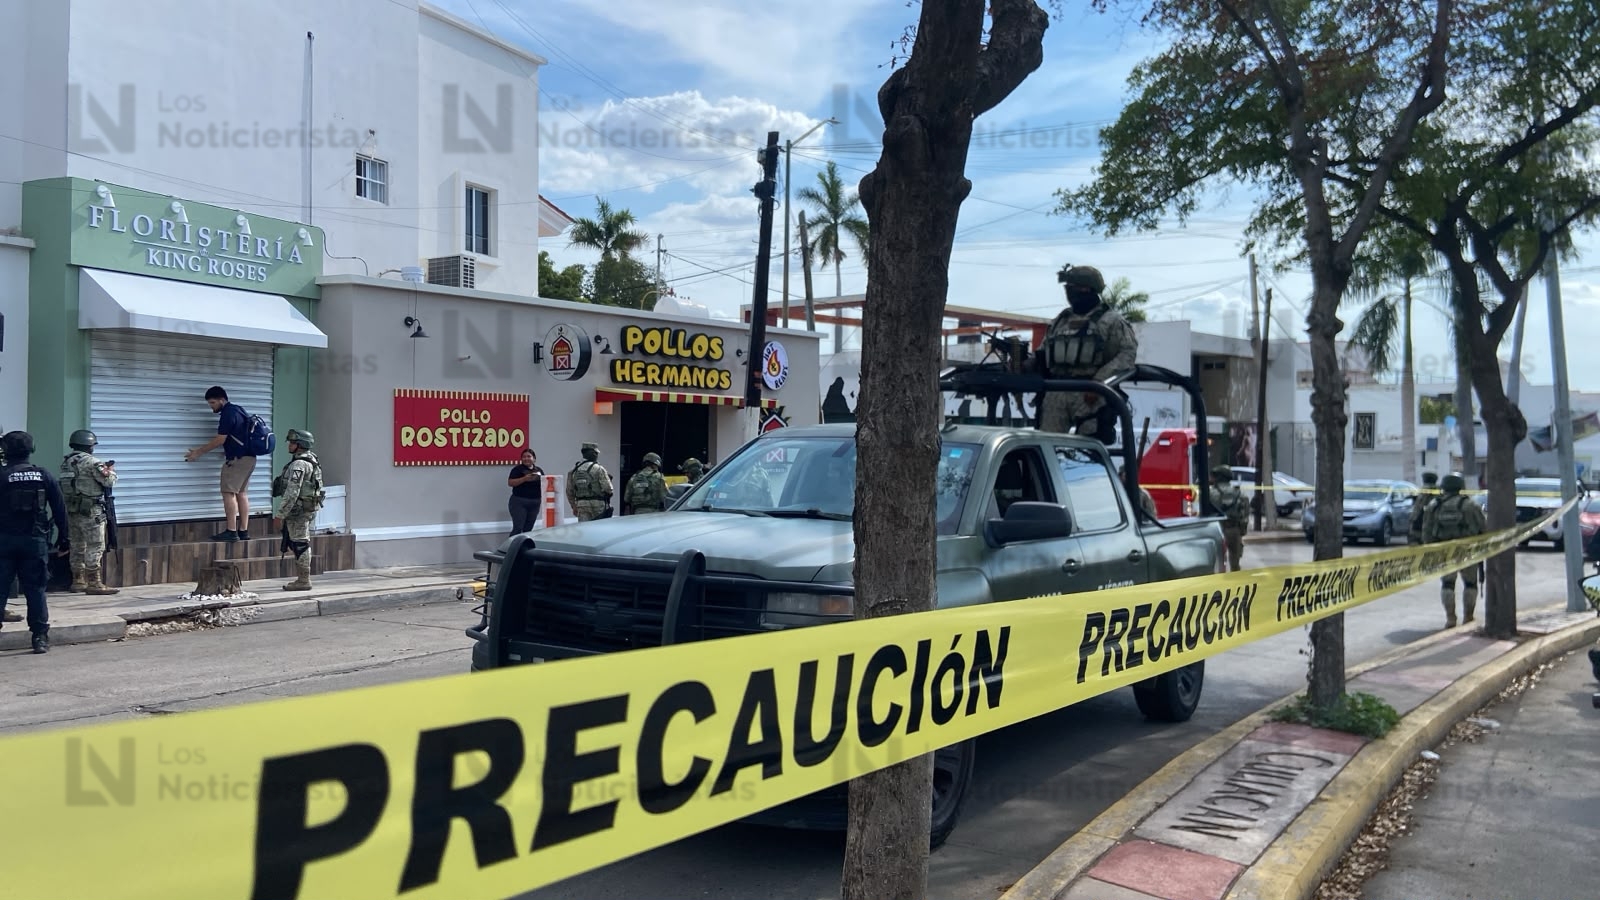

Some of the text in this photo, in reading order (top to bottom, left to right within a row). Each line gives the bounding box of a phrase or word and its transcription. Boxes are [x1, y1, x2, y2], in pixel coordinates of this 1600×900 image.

[89, 205, 303, 264] FLORISTERÍA
[147, 248, 267, 282] KING ROSES
[623, 325, 724, 360] POLLOS
[612, 359, 731, 389] HERMANOS
[440, 408, 491, 424] POLLO
[1077, 583, 1258, 685] PRECAUCIÓN
[251, 626, 1011, 900] PRECAUCIÓN
